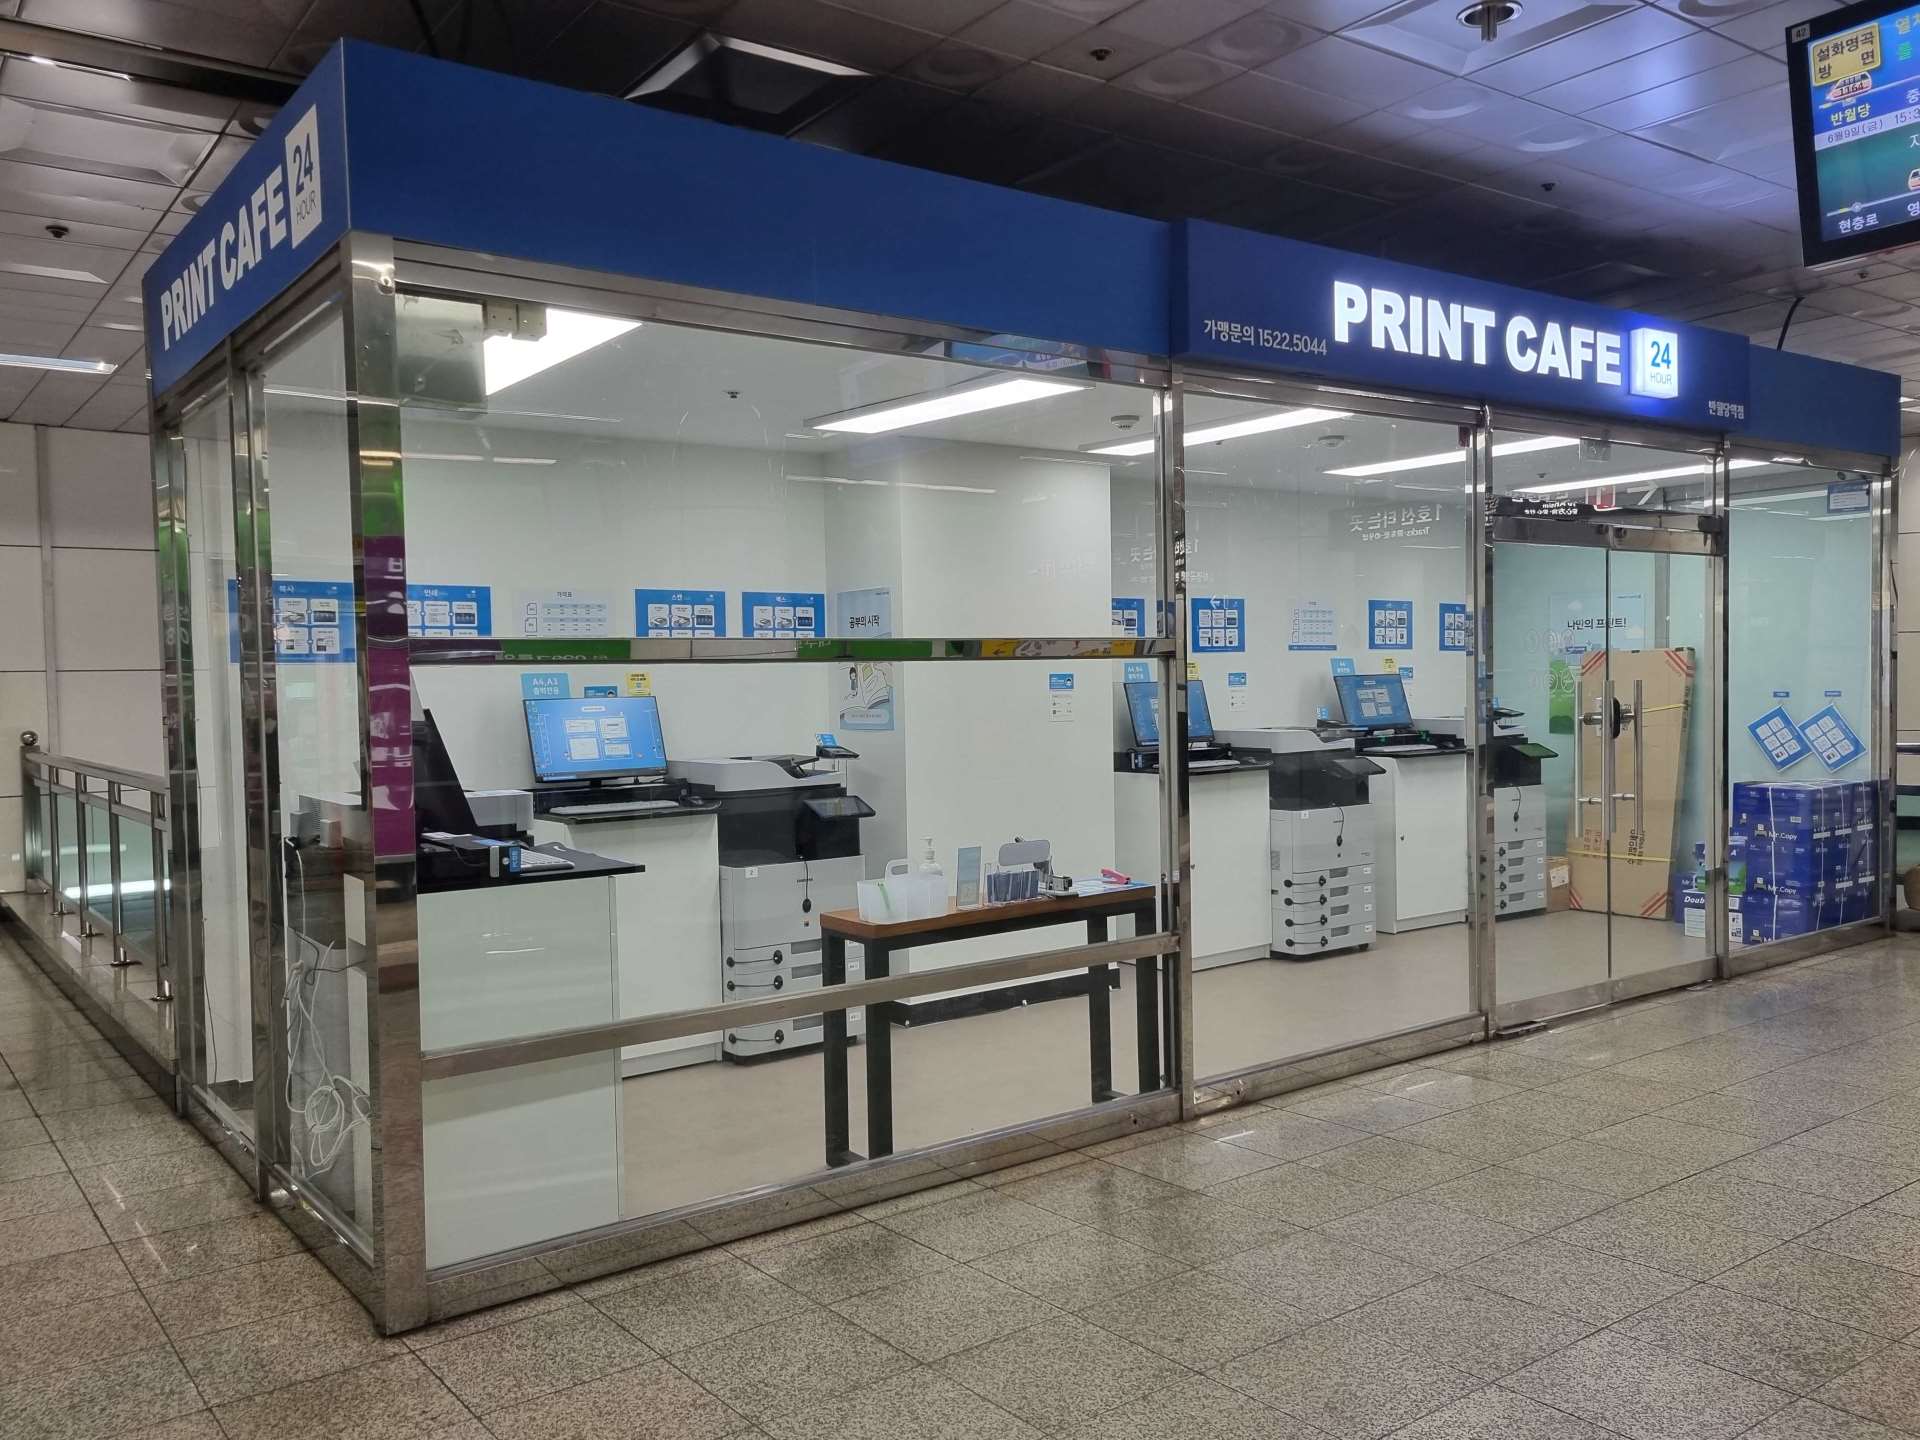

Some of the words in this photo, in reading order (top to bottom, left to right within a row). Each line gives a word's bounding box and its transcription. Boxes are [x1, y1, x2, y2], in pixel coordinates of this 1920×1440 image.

[1817, 31, 1875, 63] 설화명곡
[1819, 64, 1832, 79] 방
[1861, 48, 1874, 65] 면
[1831, 103, 1871, 126] 반월당
[293, 133, 313, 196] 24
[296, 190, 317, 224] HOUR
[1838, 213, 1879, 233] 현충로
[161, 238, 216, 351] PRINT
[220, 164, 287, 290] CAFE
[1203, 319, 1254, 346] 가맹문의
[1257, 328, 1328, 355] 1522.5044
[1334, 280, 1495, 365] PRINT
[1505, 315, 1623, 386] CAFE
[1650, 340, 1672, 370] 24
[1650, 372, 1672, 385] HOUR
[867, 614, 880, 627] 시작
